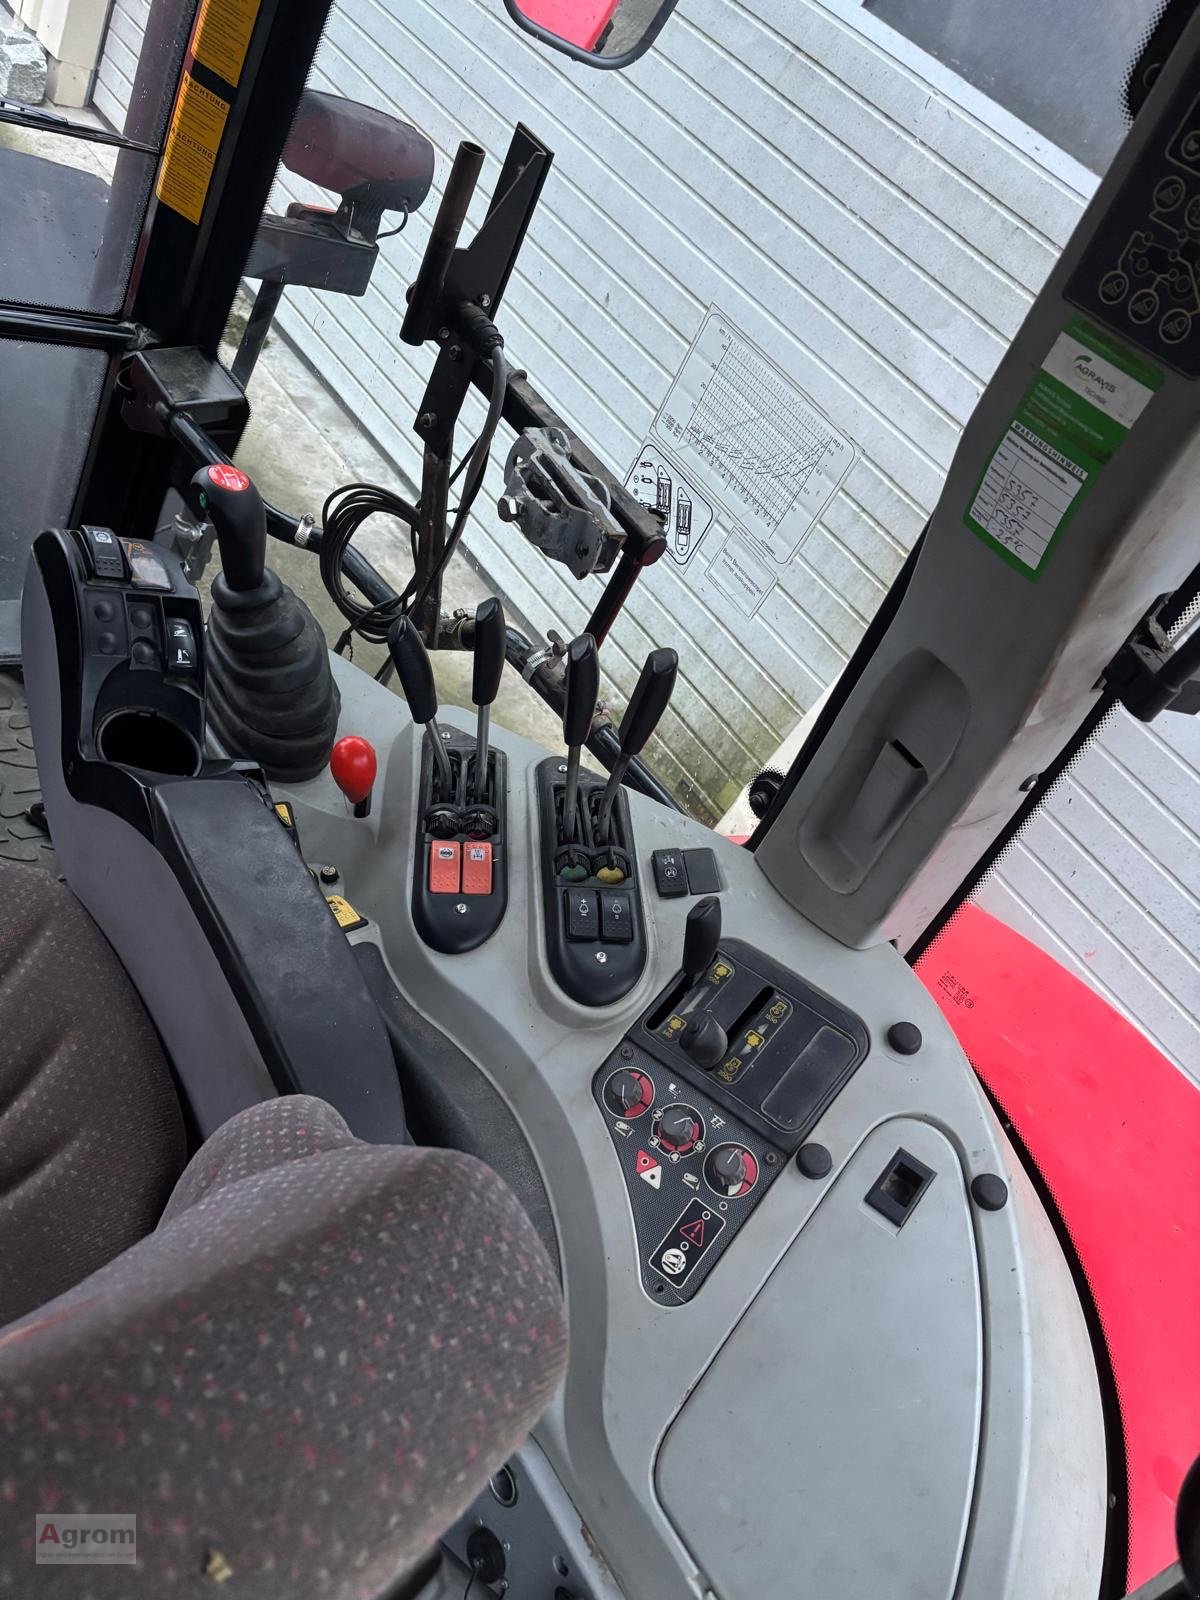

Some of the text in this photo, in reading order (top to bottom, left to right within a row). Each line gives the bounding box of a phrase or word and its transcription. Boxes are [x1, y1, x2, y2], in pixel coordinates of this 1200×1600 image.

[188, 80, 227, 111] ACHTUNG
[175, 130, 214, 160] ACHTUNG
[1075, 363, 1117, 394] AGRAVIS
[1013, 422, 1085, 478] WARTUNGSHINWEIS
